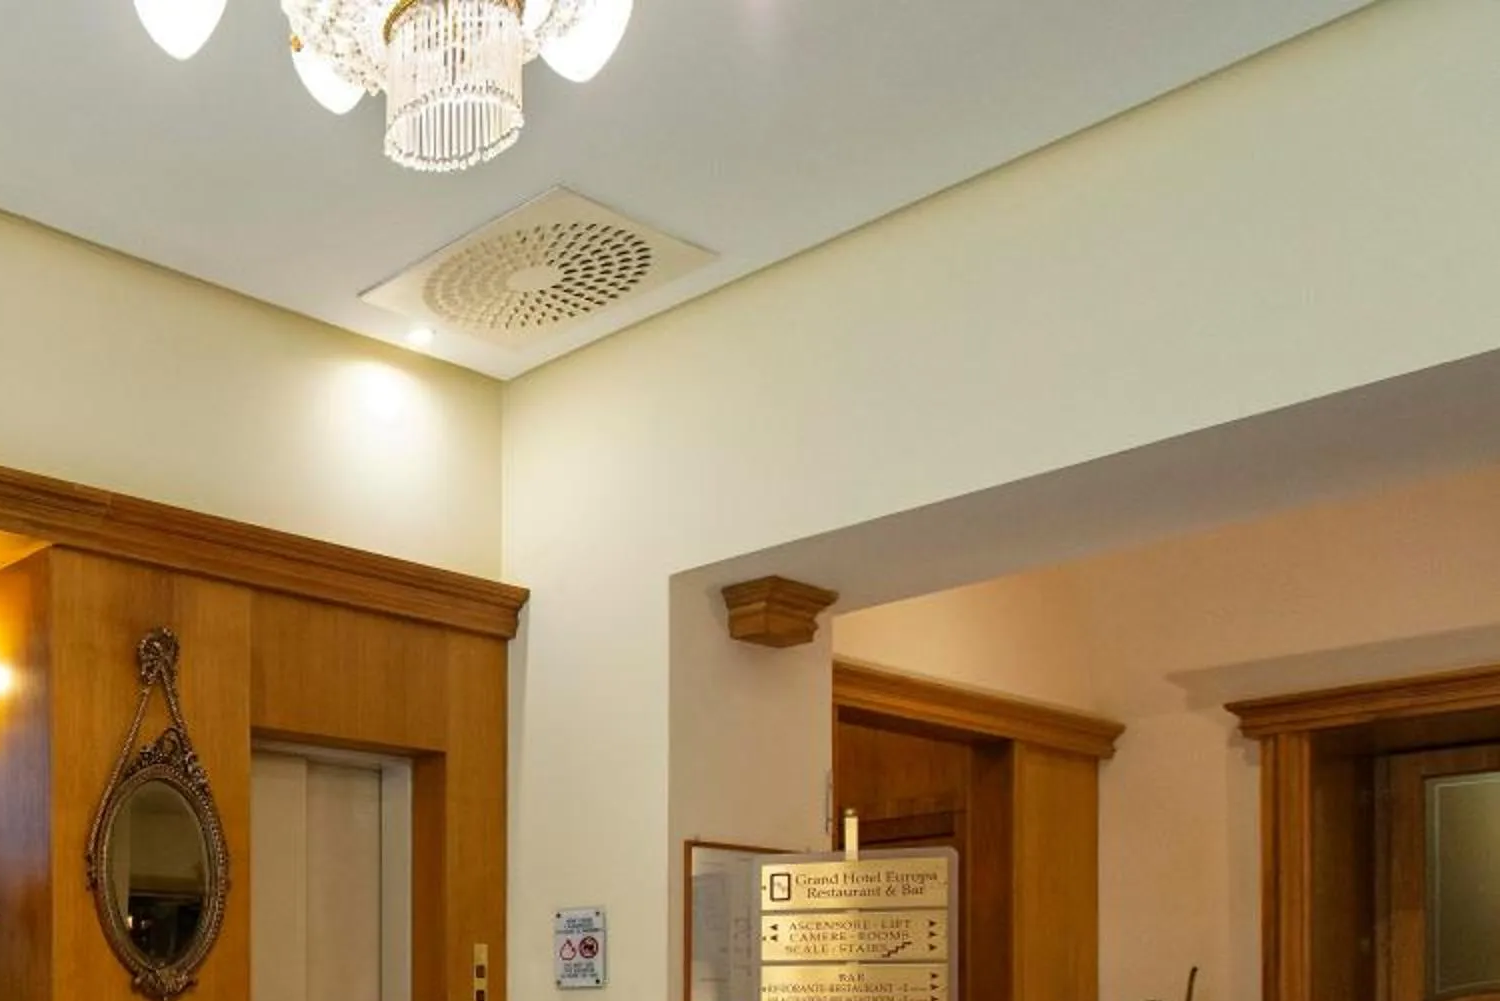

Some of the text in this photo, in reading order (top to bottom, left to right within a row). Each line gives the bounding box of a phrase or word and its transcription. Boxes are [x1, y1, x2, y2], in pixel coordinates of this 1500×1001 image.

[795, 871, 938, 885] Grand Hotel Europa
[807, 886, 881, 898] Restaurant
[885, 885, 896, 897] &
[789, 931, 848, 942] CAMERE
